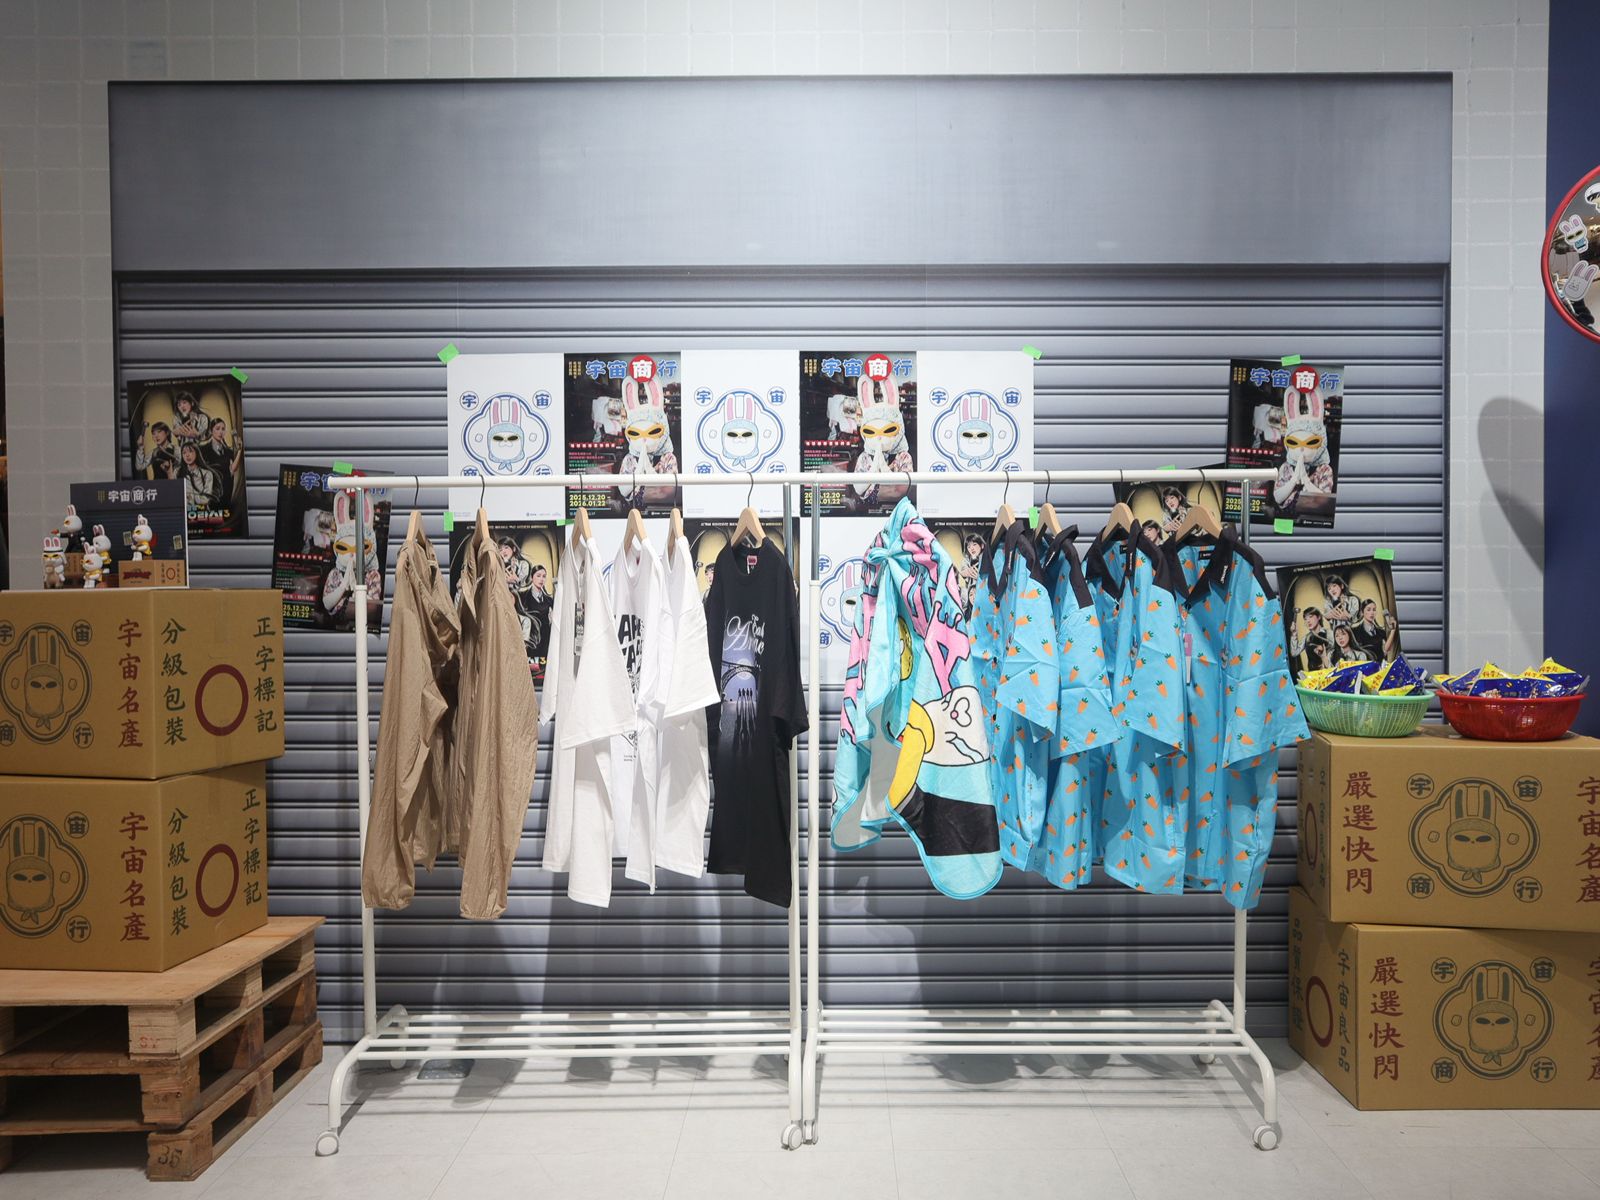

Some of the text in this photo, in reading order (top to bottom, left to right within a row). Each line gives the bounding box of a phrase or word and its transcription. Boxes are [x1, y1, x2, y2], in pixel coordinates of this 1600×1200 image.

[585, 359, 677, 380] 宇宙商行
[821, 357, 913, 378] 宇宙商行
[1250, 367, 1341, 390] 宇宙商行
[108, 488, 158, 504] 宇宙商行
[1225, 497, 1260, 506] 2025.20
[1225, 503, 1260, 512] 2026.22
[282, 604, 310, 612] 25.12.20
[282, 610, 309, 618] 26.01.22
[73, 624, 91, 643] 宙
[117, 618, 143, 748] 宇宙名產
[161, 617, 188, 746] 分級包裝
[253, 616, 278, 733] 正字標記
[75, 726, 93, 746] 行
[1410, 777, 1431, 795] 宇
[1516, 780, 1539, 798] 宙
[68, 816, 88, 835] 宙
[1341, 771, 1378, 894] 嚴選快閃
[242, 788, 262, 907] 正字標記
[119, 811, 150, 943] 宇宙名產
[168, 807, 190, 937] 分級包裝
[1410, 876, 1432, 895] 商
[1516, 880, 1539, 899] 行
[69, 919, 89, 939] 行
[1433, 961, 1454, 980] 宇
[1533, 960, 1553, 979] 宙
[1337, 948, 1351, 1073] 宇宙良品
[1368, 956, 1406, 1081] 嚴選快閃
[1433, 1060, 1454, 1080] 商
[1533, 1060, 1554, 1079] 行
